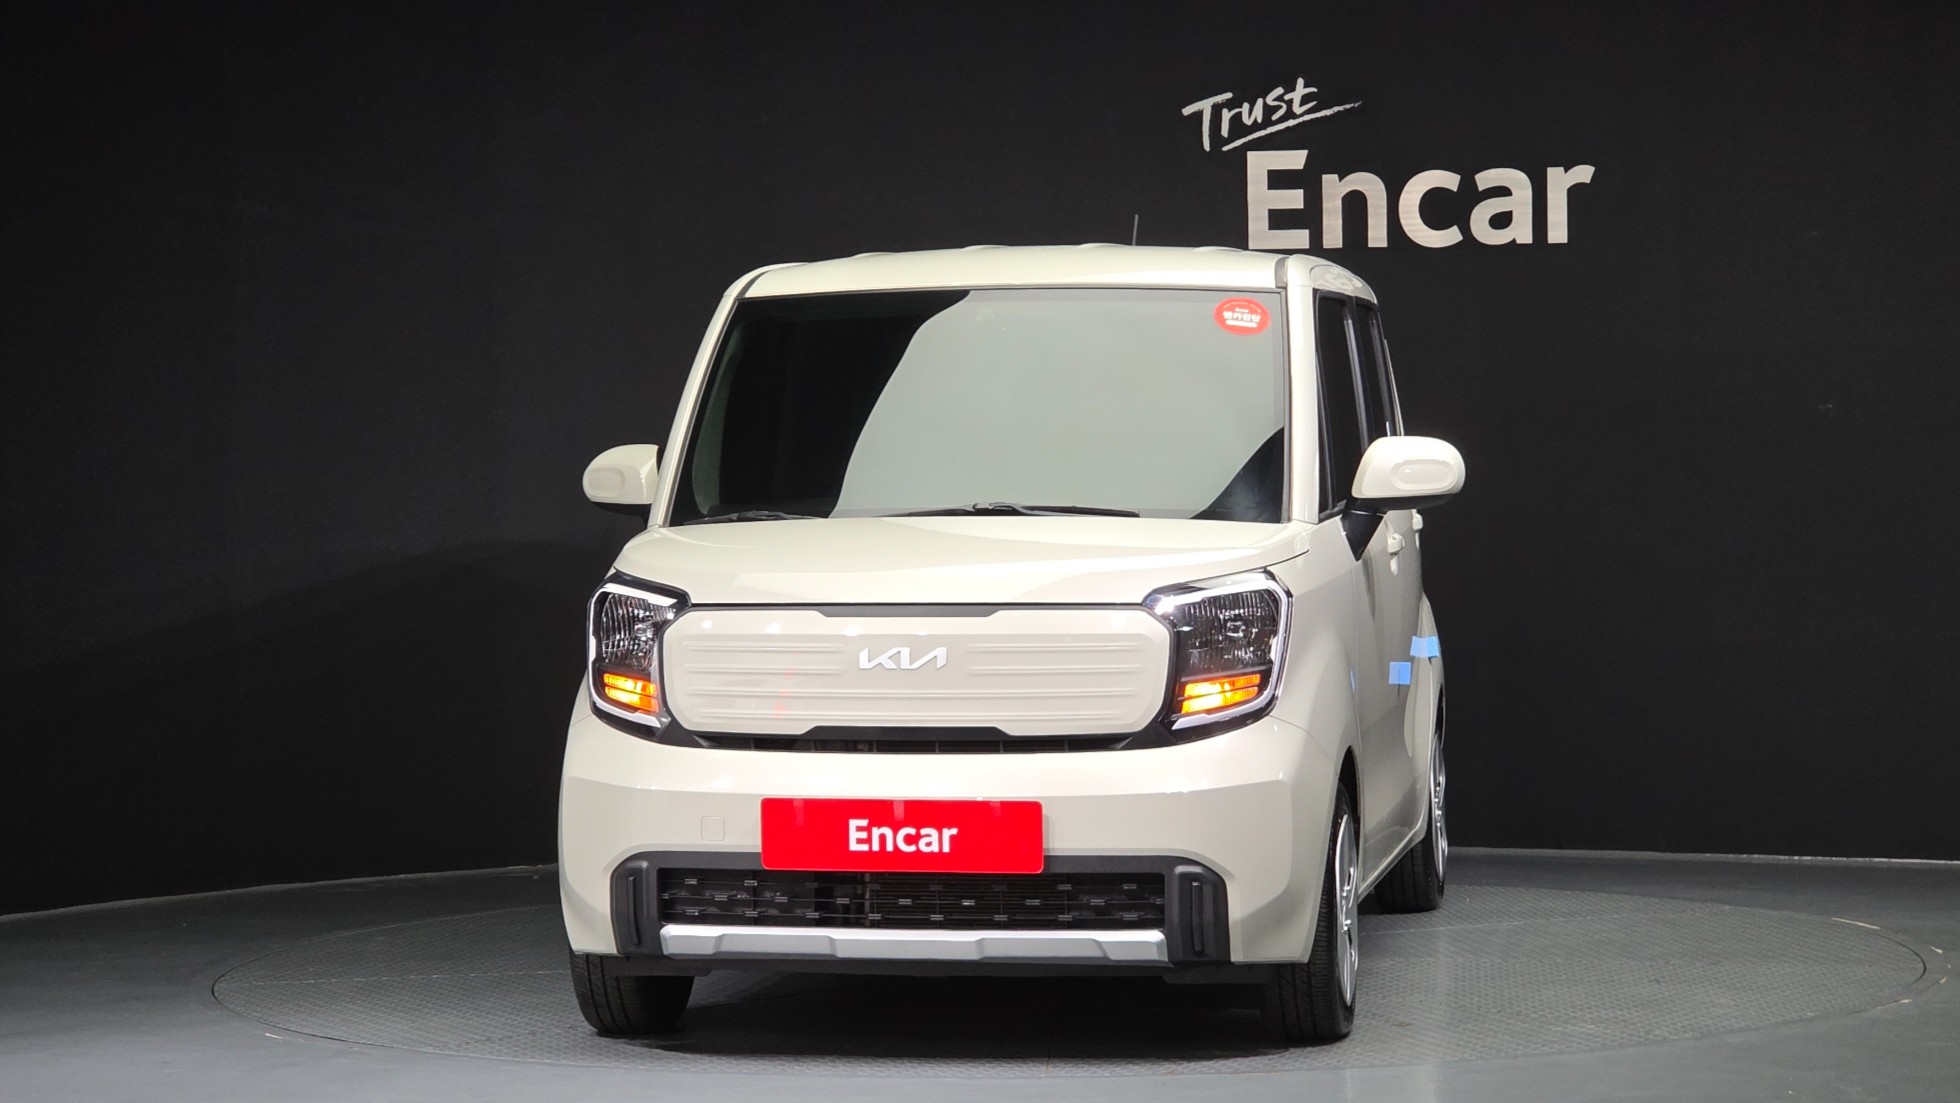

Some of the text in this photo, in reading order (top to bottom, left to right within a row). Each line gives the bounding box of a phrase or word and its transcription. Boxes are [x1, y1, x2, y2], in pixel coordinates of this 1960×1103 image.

[1182, 77, 1318, 151] Trust
[1247, 149, 1596, 249] Encar
[848, 818, 959, 853] Encar
